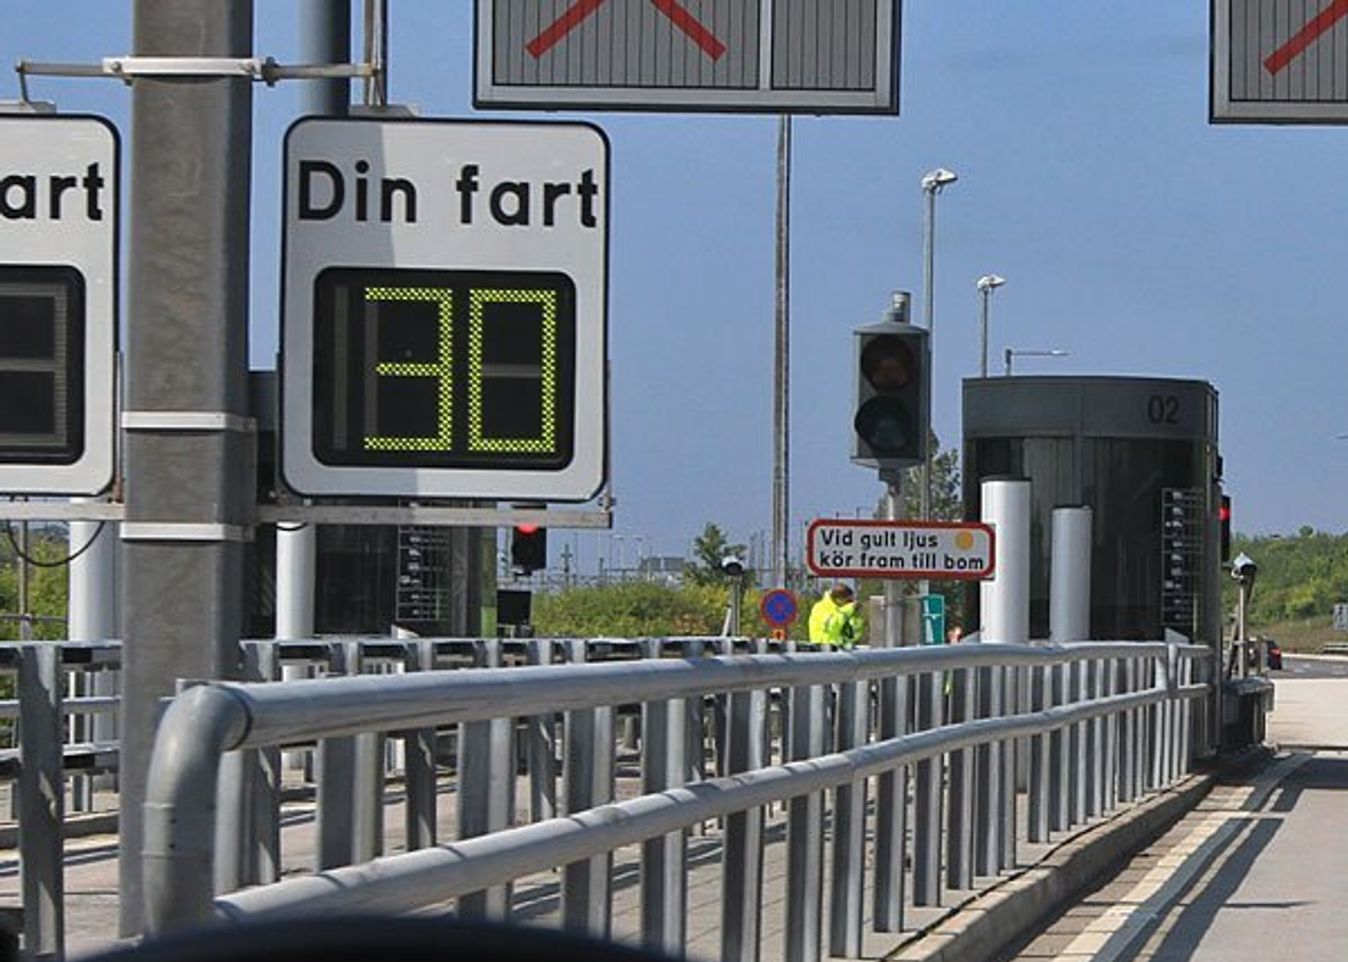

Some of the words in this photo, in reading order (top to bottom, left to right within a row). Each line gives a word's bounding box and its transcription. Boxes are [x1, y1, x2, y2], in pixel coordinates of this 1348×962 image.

[298, 160, 417, 223] Din
[456, 164, 598, 228] fart
[364, 287, 557, 453] 30
[1147, 394, 1180, 424] 02
[820, 529, 853, 546] Vid
[860, 530, 896, 550] gult
[903, 531, 938, 550] ljus
[820, 550, 853, 567] kör
[860, 552, 904, 568] fram
[912, 554, 936, 569] till
[943, 554, 983, 569] bom
